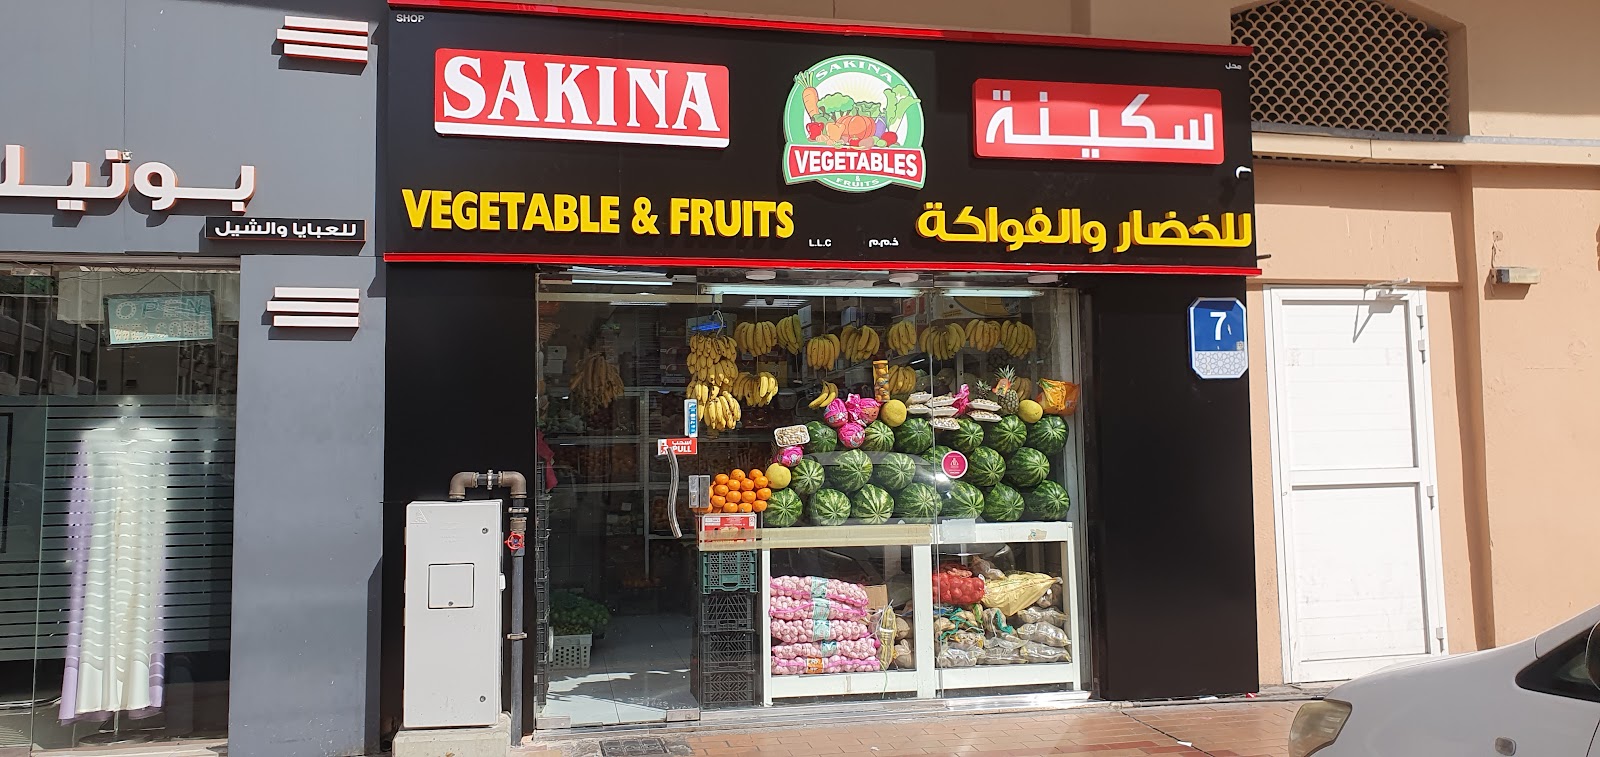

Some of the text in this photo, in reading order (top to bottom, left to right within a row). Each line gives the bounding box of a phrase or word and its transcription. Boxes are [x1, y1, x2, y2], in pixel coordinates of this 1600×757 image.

[396, 13, 425, 23] SHOP
[815, 60, 893, 84] SAKINA
[1224, 61, 1242, 70] محل
[443, 56, 721, 132] SAKINA
[985, 89, 1215, 158] سكينة
[794, 150, 918, 178] VEGETABLES
[835, 177, 880, 188] FRUITS
[402, 188, 796, 239] VEGETABLE & FRUITS
[214, 218, 357, 238] للعبايا والشيل
[915, 201, 1252, 253] للخضار والفواكة
[116, 298, 205, 320] OPEN
[1209, 311, 1227, 341] 7
[672, 445, 692, 453] PULL
